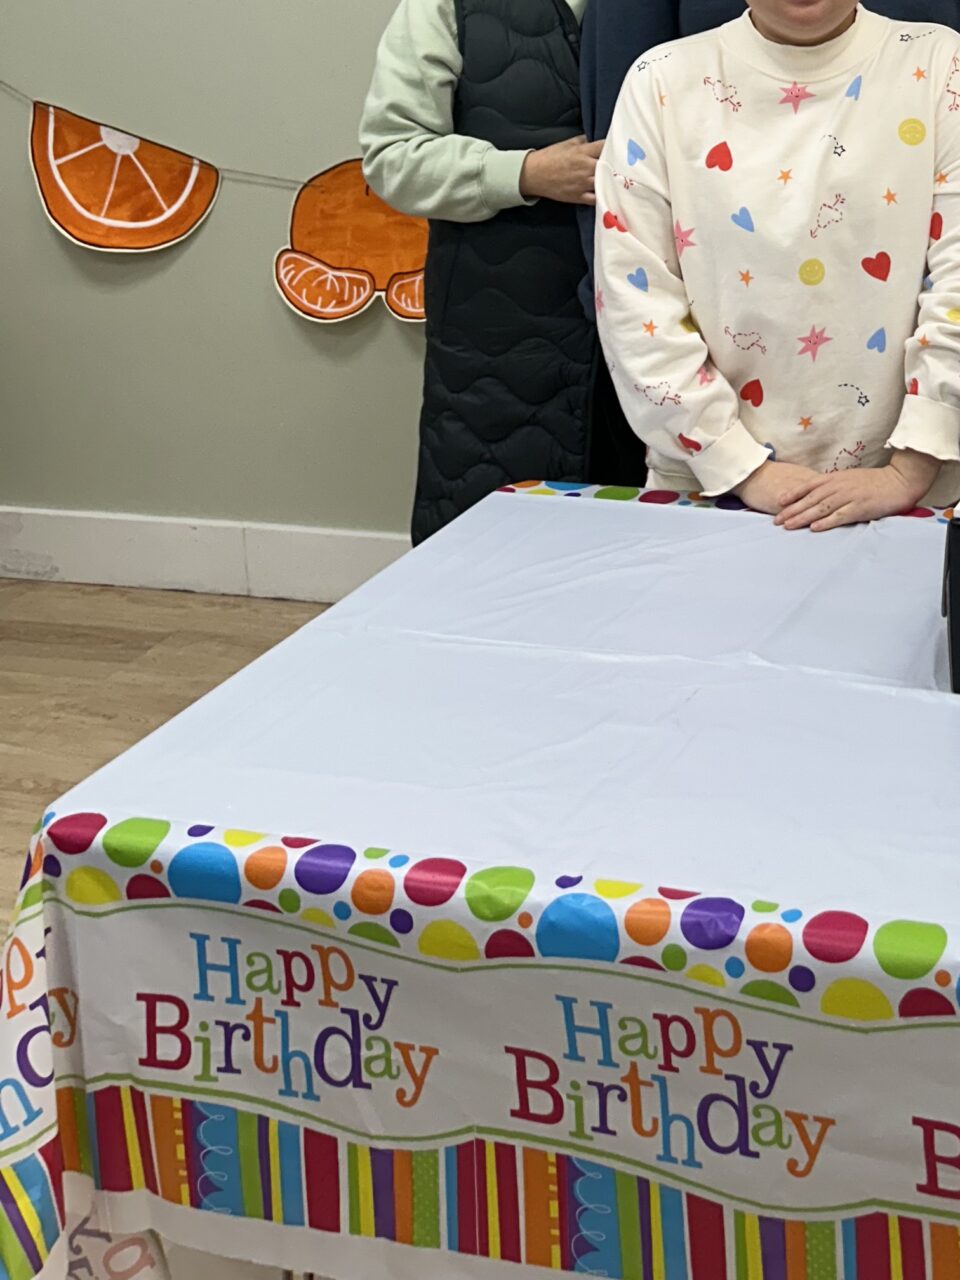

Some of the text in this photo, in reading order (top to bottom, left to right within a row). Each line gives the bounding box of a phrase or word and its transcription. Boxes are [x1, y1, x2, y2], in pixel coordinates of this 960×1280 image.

[189, 932, 399, 1031] Happy
[136, 992, 440, 1109] Birthday
[555, 994, 794, 1099] Happy
[504, 1045, 836, 1178] Birthday
